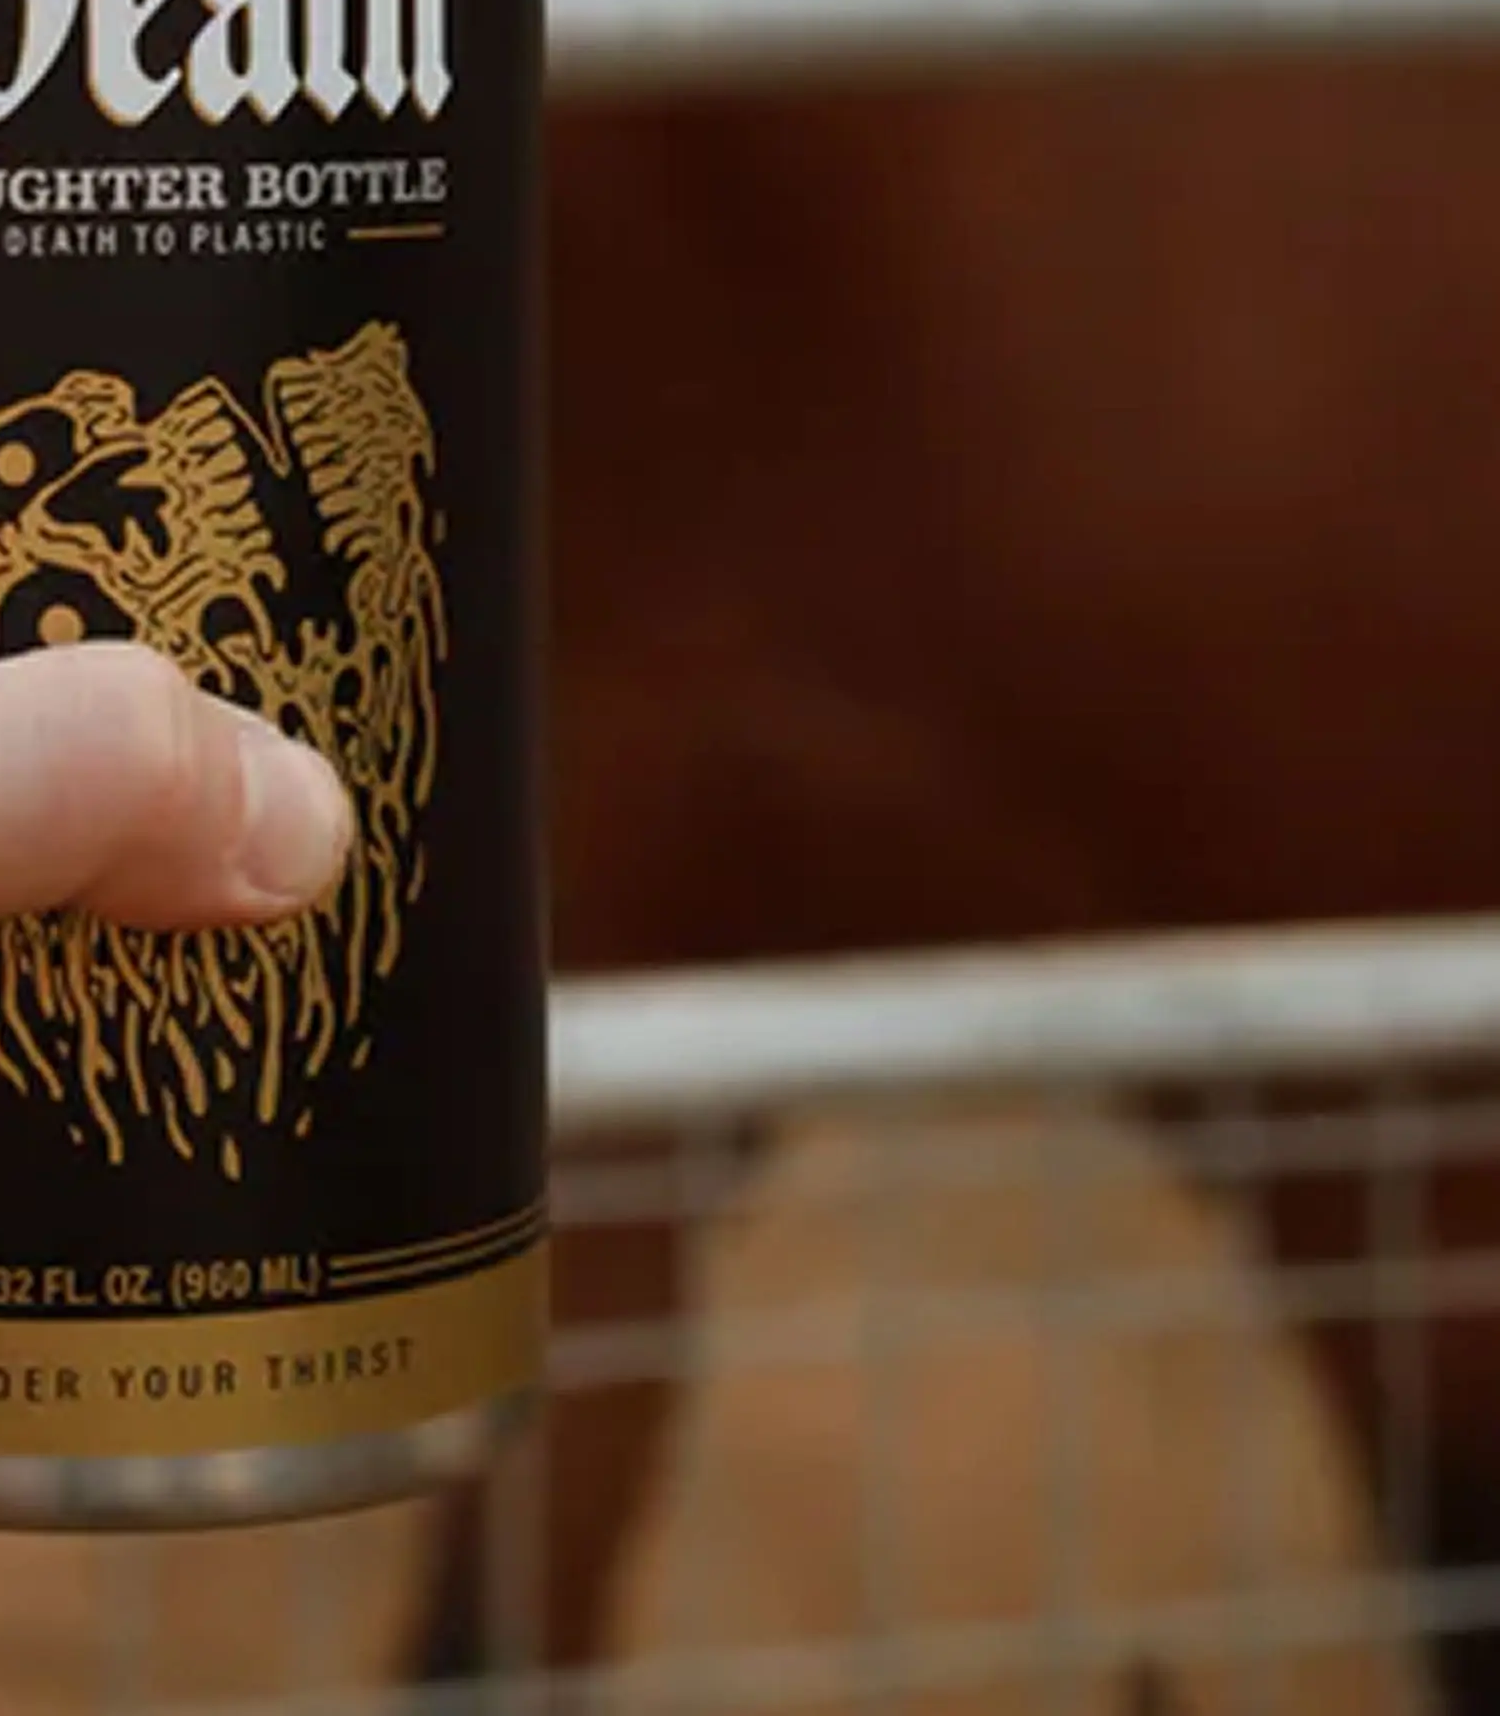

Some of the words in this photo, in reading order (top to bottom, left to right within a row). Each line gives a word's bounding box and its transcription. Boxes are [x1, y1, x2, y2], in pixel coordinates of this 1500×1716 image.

[245, 158, 448, 206] BOTTLE
[4, 225, 119, 257] DEATH
[132, 224, 177, 255] TO
[189, 220, 328, 254] PLASTIC
[43, 1265, 99, 1306] FL.
[105, 1264, 163, 1306] OZ.
[110, 1358, 238, 1400] YOUR
[265, 1337, 417, 1392] THIRST
